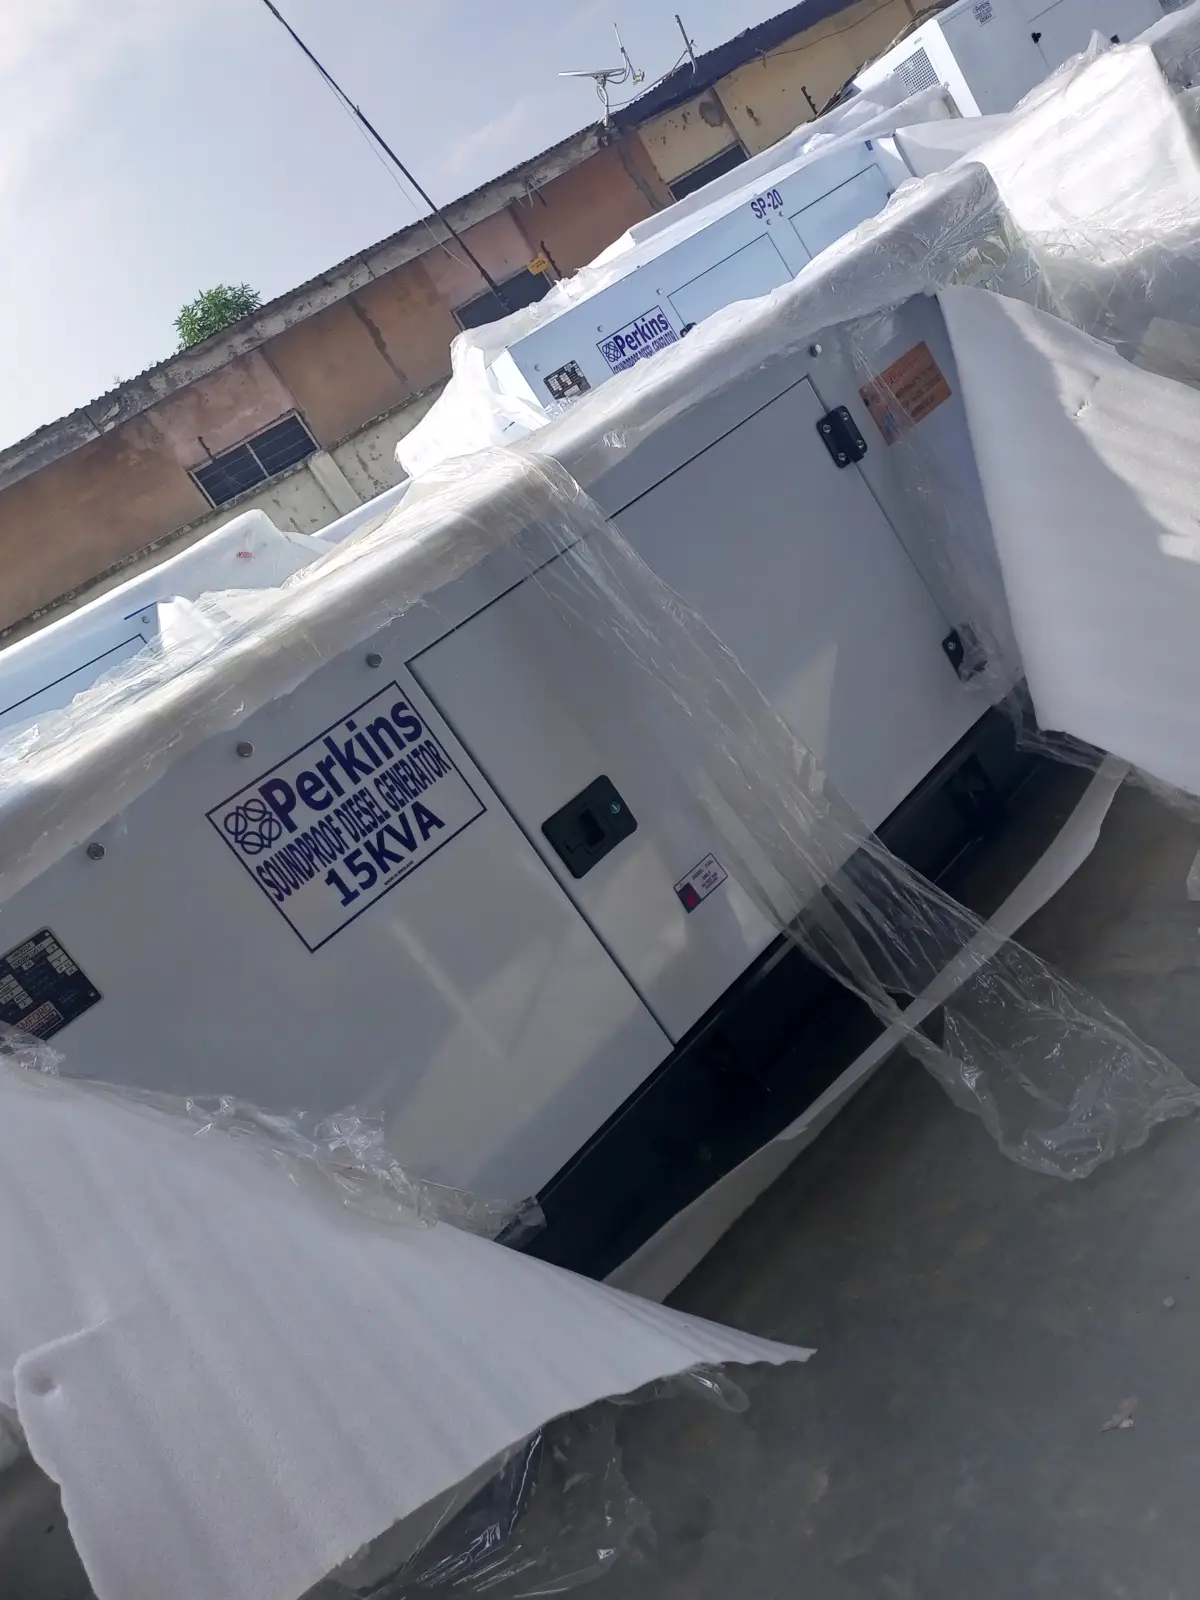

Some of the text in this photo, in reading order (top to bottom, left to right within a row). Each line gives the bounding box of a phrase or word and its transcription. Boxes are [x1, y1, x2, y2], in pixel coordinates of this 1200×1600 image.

[751, 189, 783, 219] SP-20
[612, 313, 669, 357] Perkins
[256, 739, 453, 902] SOUNDPROOF DIESEL GENERATOR
[258, 701, 423, 834] Perkins
[324, 800, 446, 908] 15KVA
